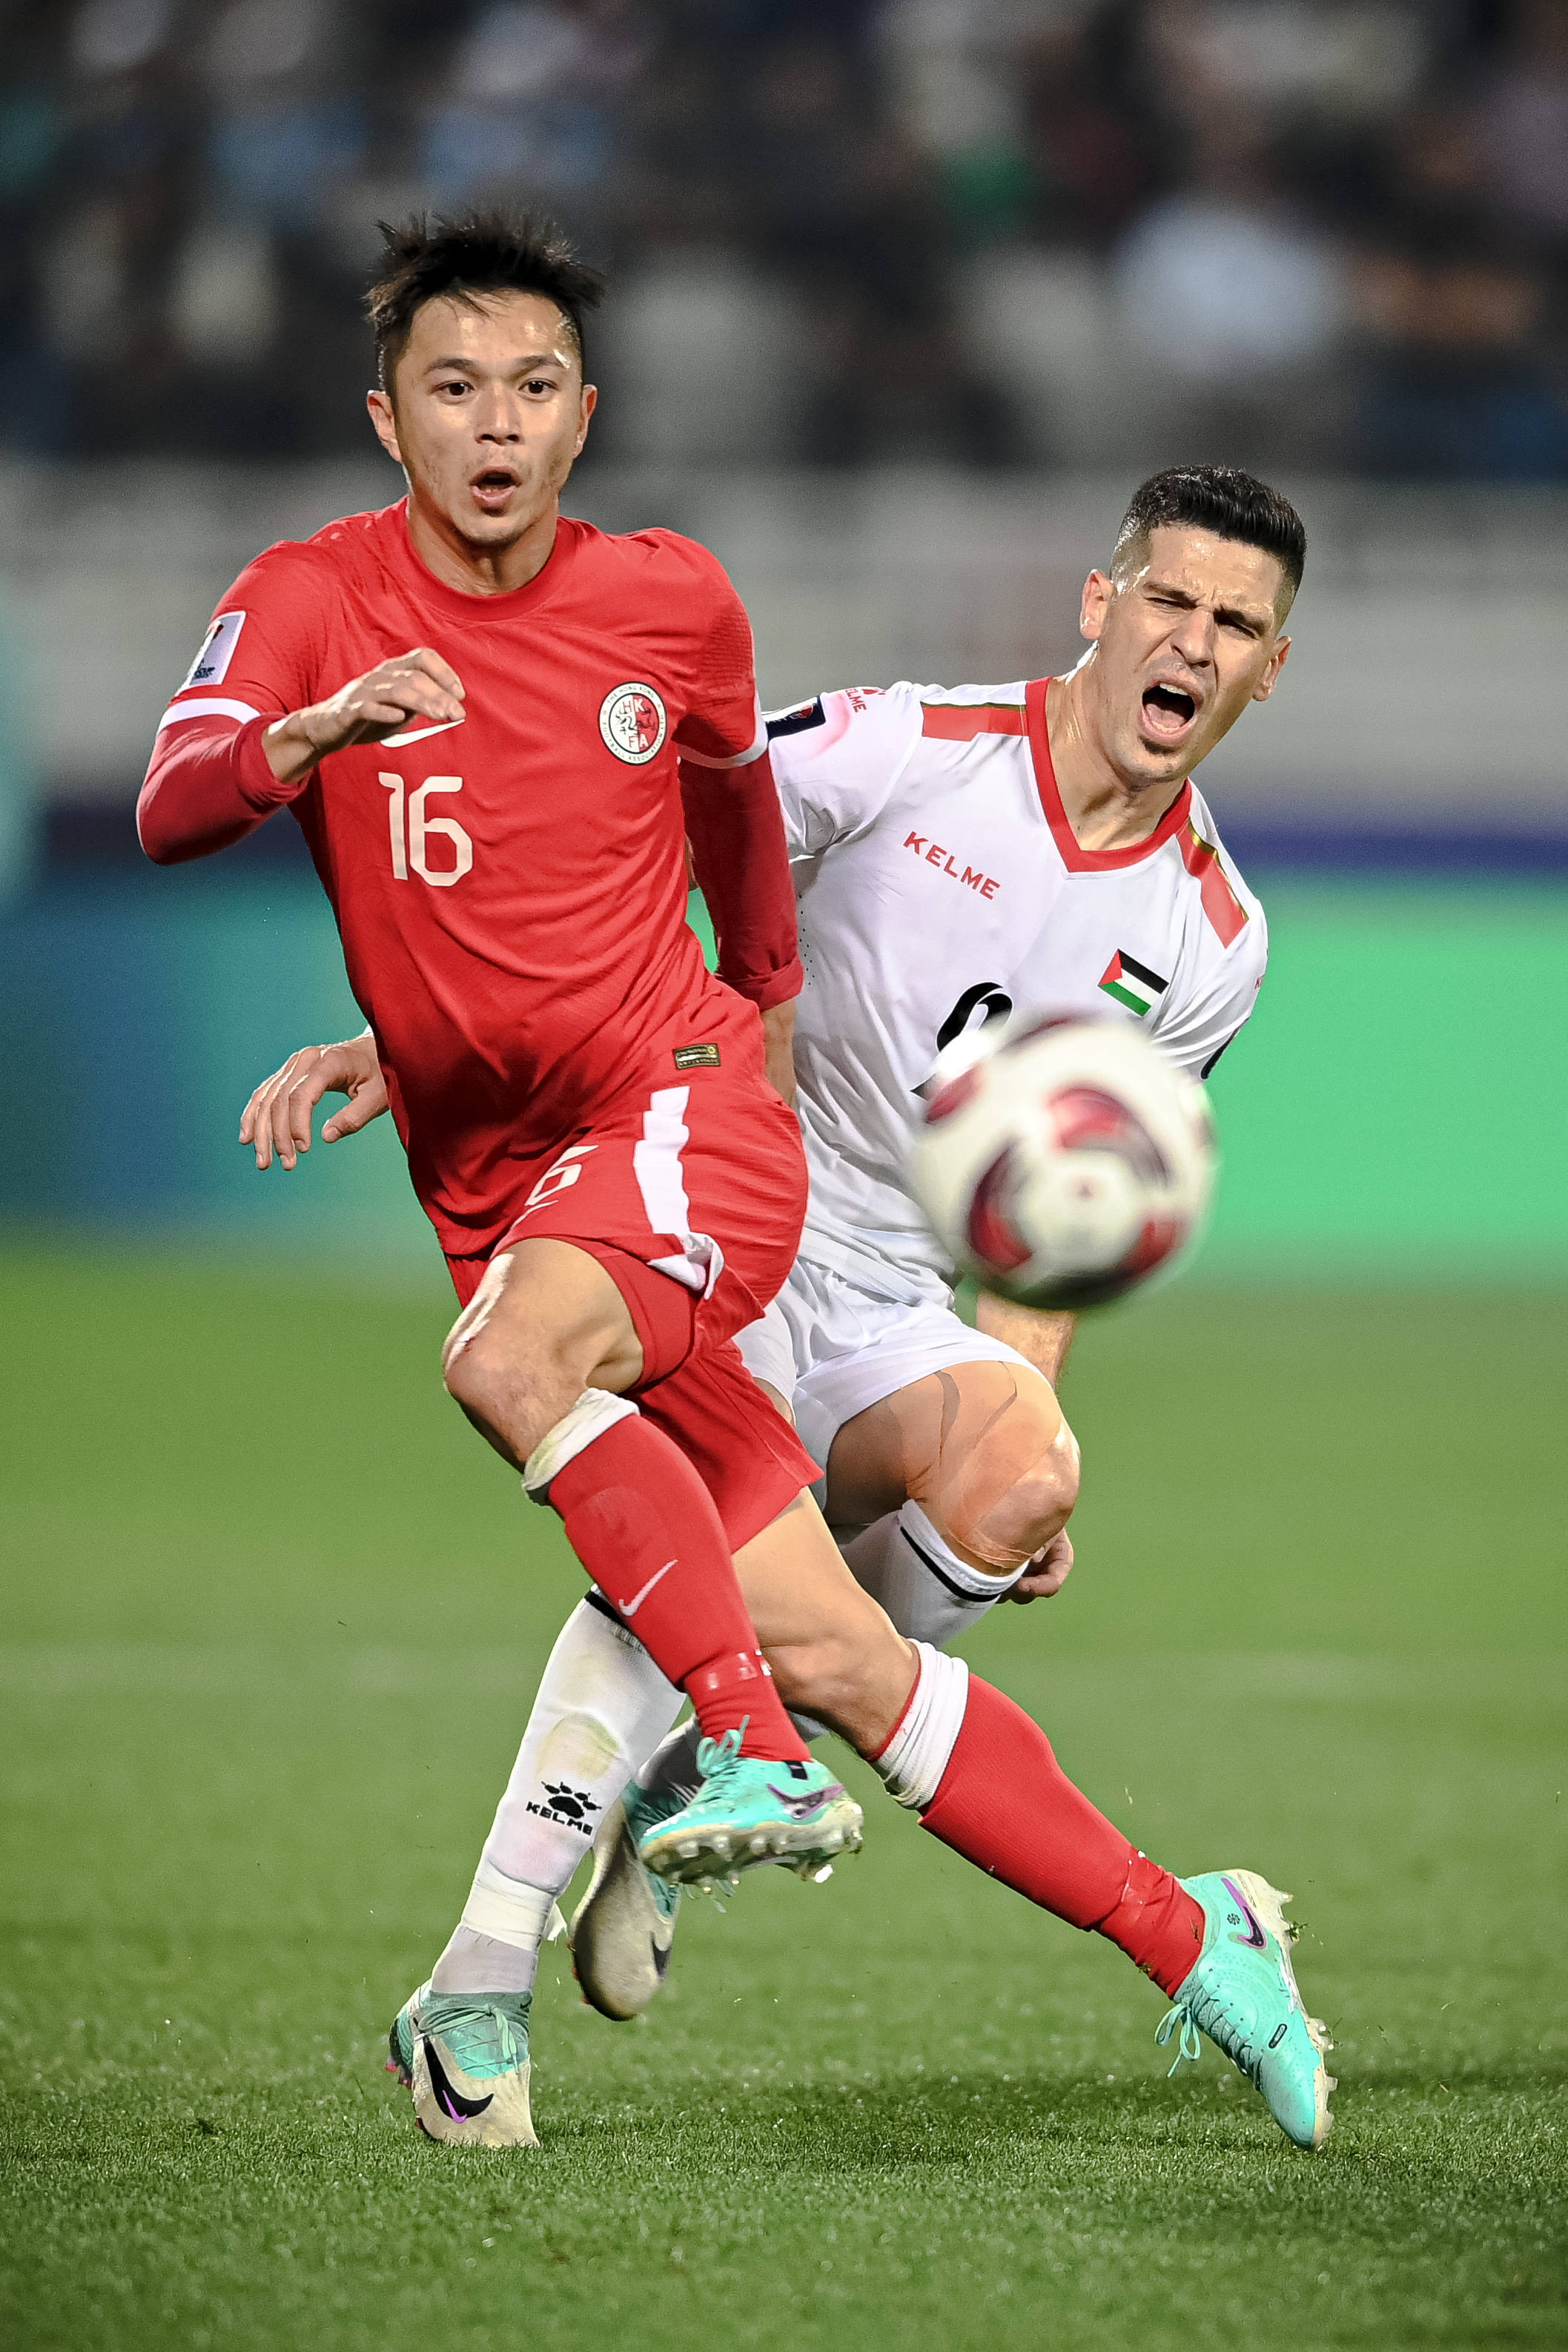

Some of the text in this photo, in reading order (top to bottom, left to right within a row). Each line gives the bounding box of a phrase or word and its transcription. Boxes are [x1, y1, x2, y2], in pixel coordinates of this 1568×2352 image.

[622, 698, 645, 713] HK
[844, 688, 867, 713] ELME
[628, 733, 649, 748] FA
[378, 771, 473, 887] 16
[903, 831, 1000, 900] KELME
[526, 1801, 593, 1836] KELME
